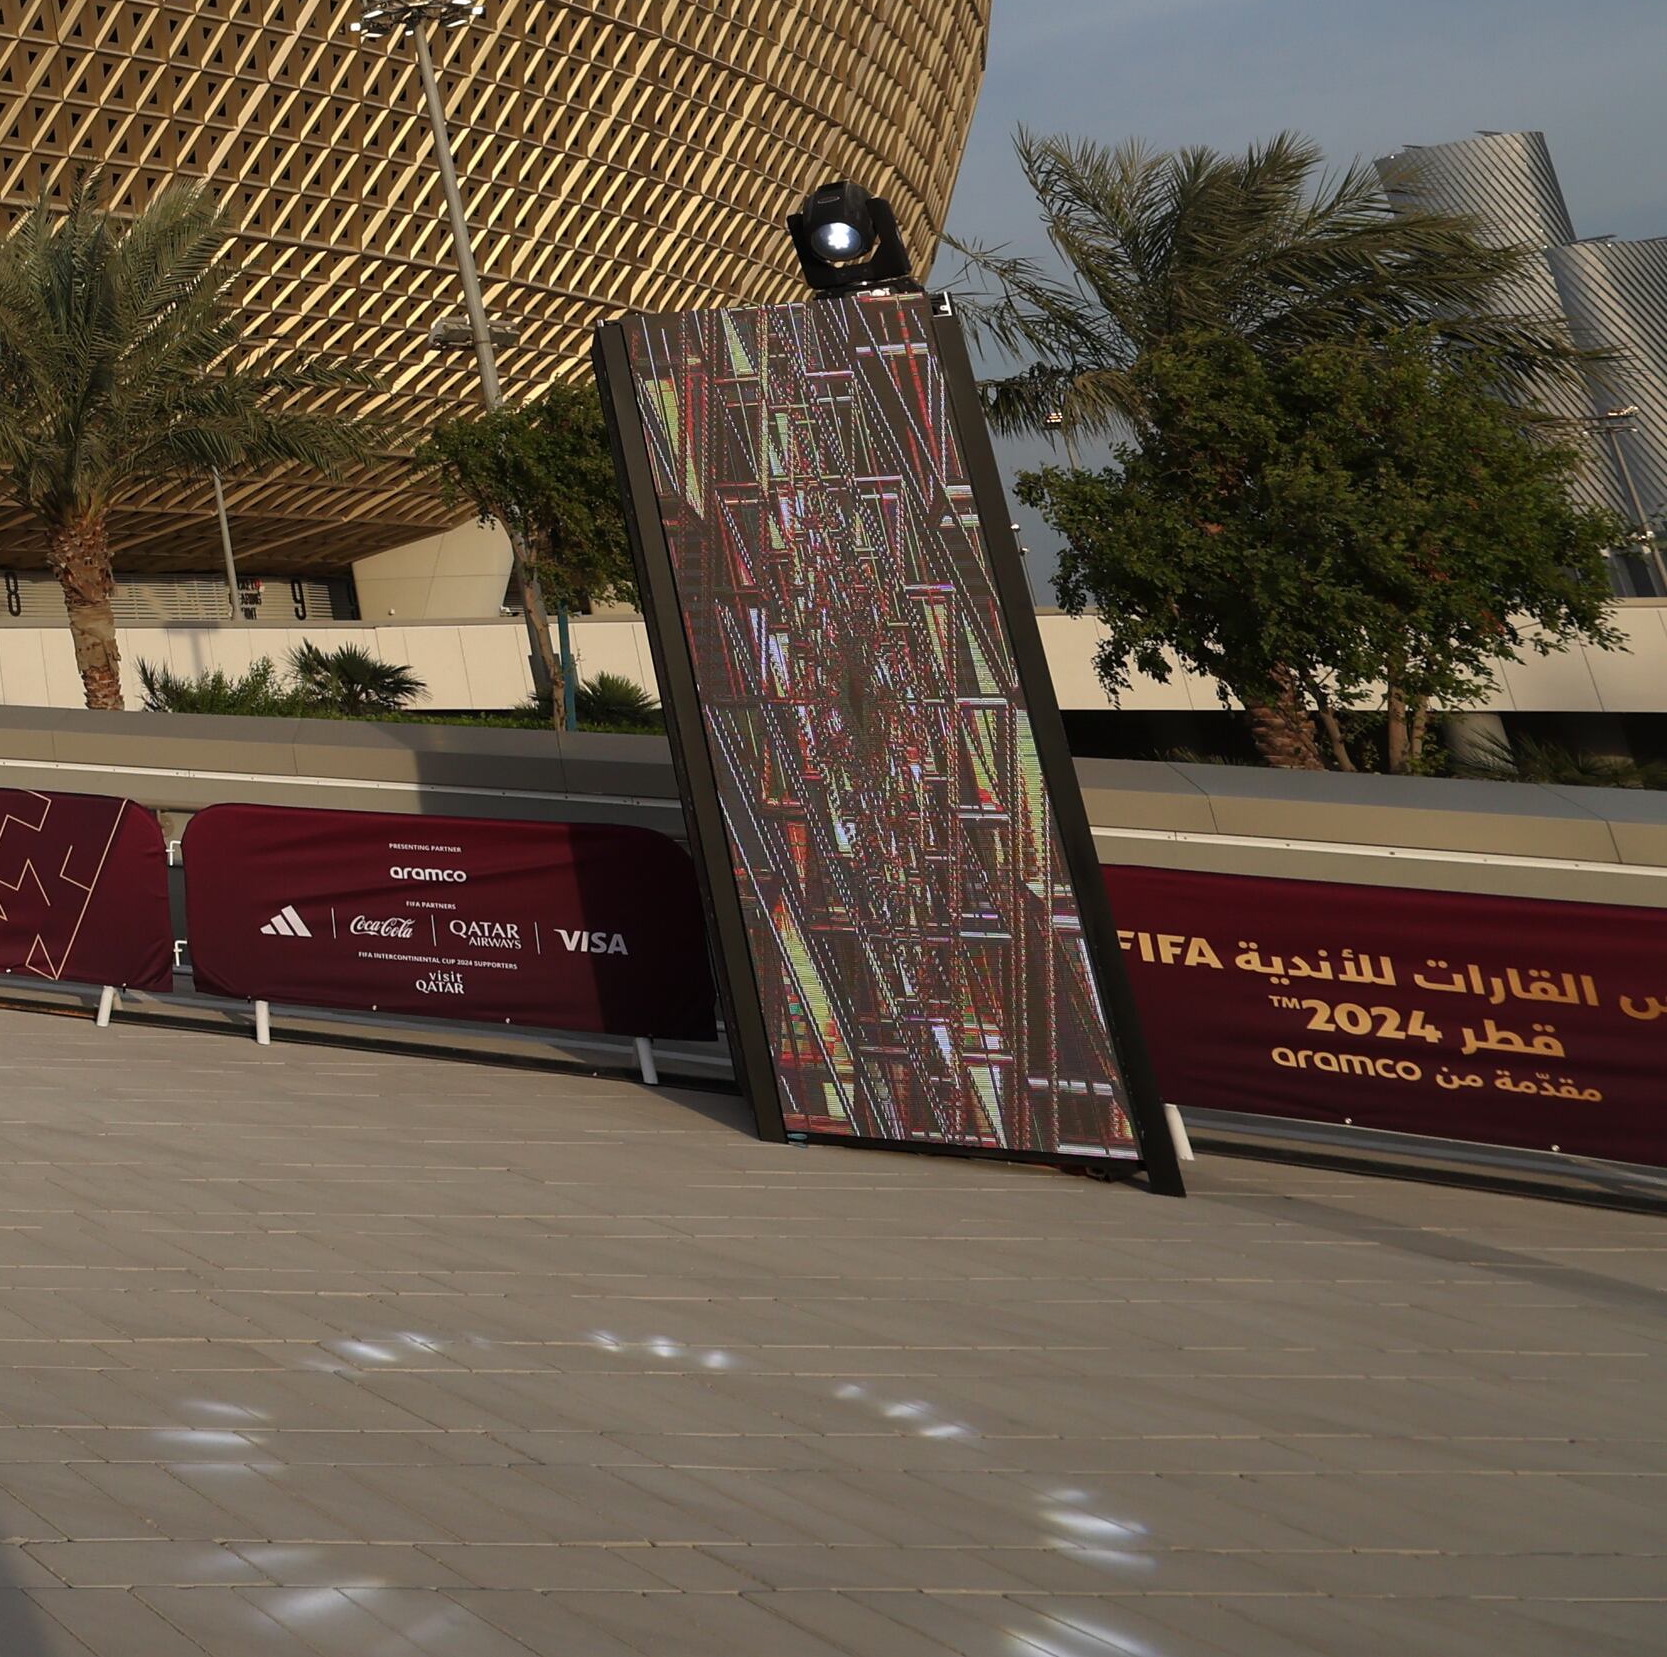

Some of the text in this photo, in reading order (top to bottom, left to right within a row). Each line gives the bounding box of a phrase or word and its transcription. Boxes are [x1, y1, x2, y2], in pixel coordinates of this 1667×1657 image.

[5, 571, 21, 617] 8
[291, 578, 307, 621] 9
[389, 843, 462, 853] PRESENTING PARTNER
[390, 866, 467, 882] aramco
[406, 900, 456, 910] FIFA PARTNERS
[449, 919, 520, 939] QATAR
[469, 936, 522, 950] AIRWAYS
[553, 929, 629, 955] VISA
[374, 953, 440, 964] INTERCONTINENTAL
[474, 960, 518, 970] SUPPORTERS
[1235, 941, 1397, 986] للأندية
[416, 980, 465, 994] QATAR
[429, 970, 463, 983] visit
[1413, 959, 1600, 1006] القارات
[1461, 1019, 1565, 1058] قطر
[1271, 1047, 1422, 1081] aramco
[1436, 1066, 1484, 1090] من
